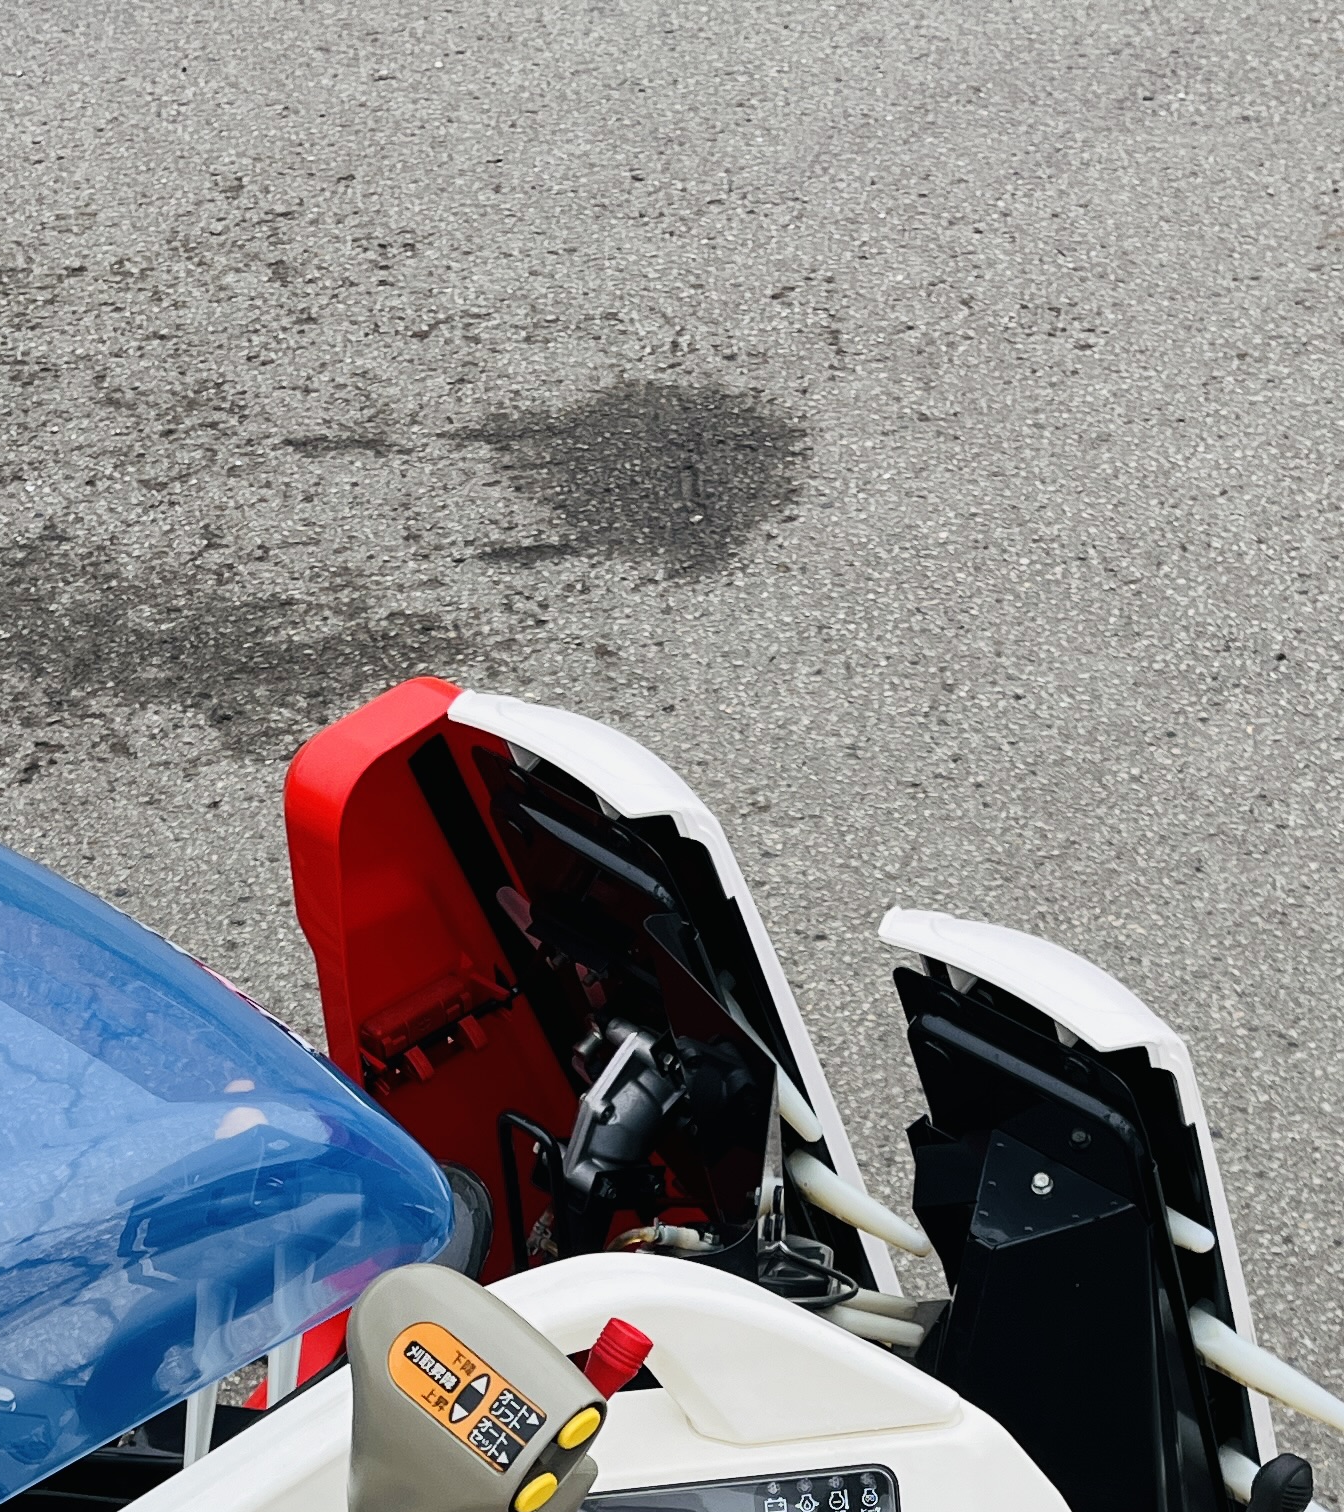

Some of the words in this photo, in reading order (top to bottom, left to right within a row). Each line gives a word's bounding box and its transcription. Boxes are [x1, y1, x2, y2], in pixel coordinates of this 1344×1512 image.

[491, 1401, 521, 1429] リフト
[499, 1389, 530, 1418] オート
[470, 1429, 499, 1457] セット
[477, 1418, 508, 1445] オート
